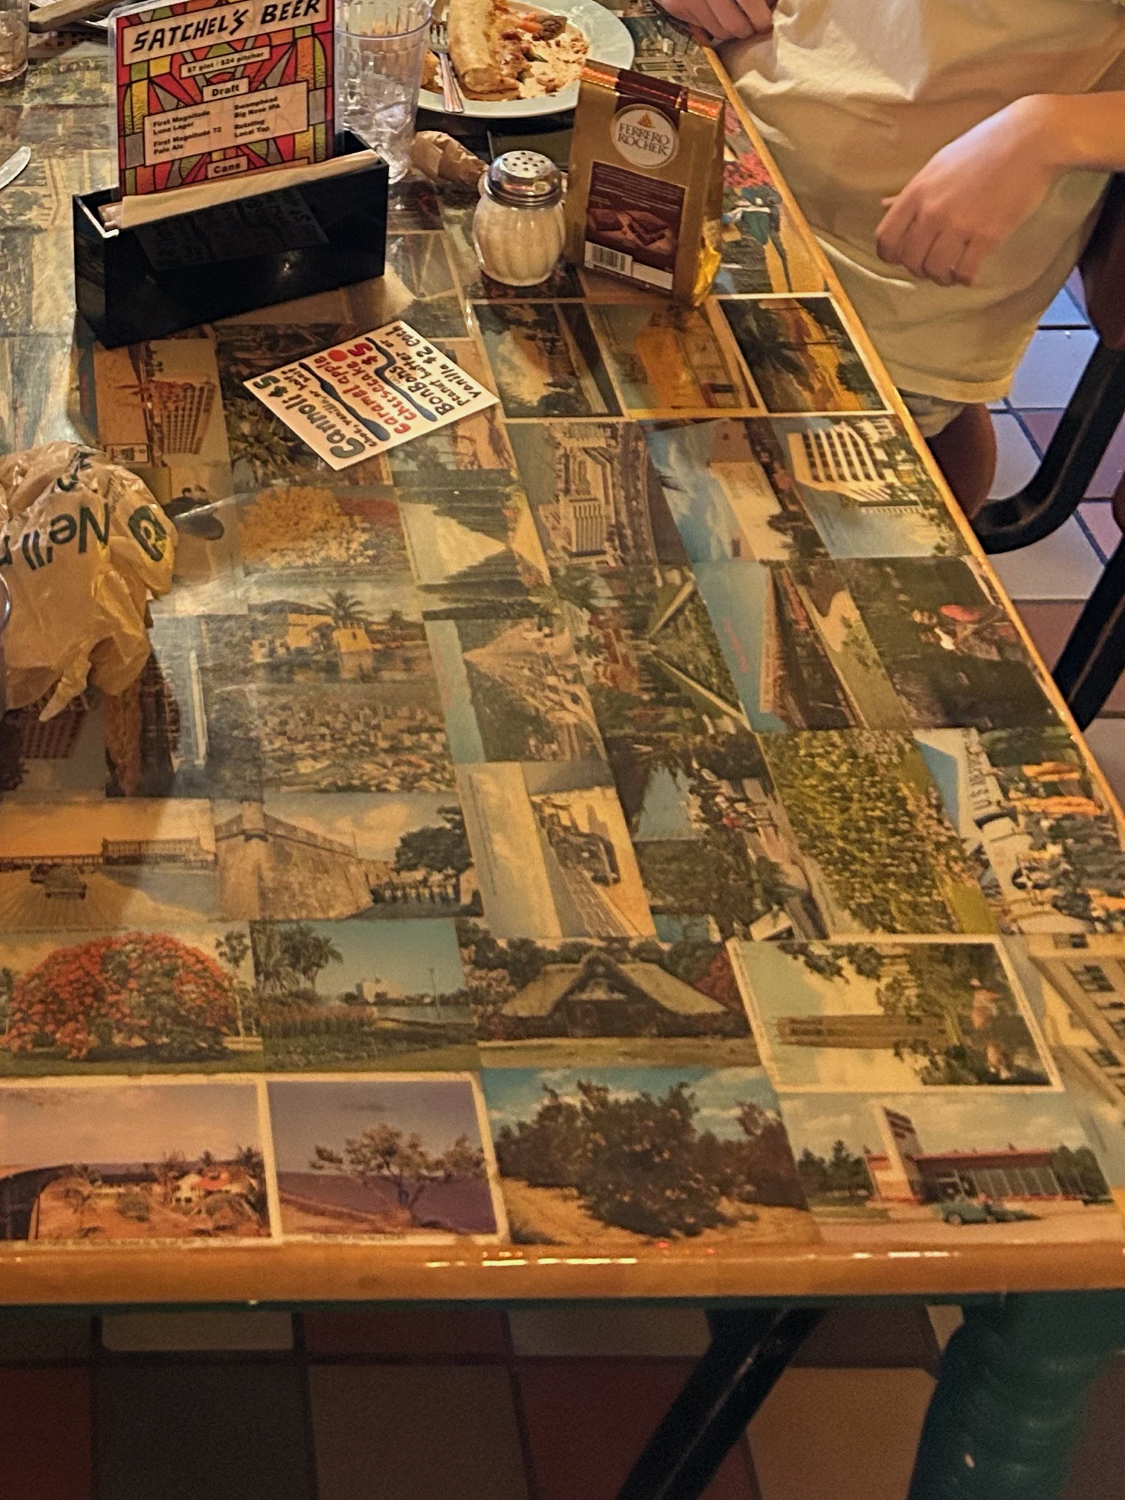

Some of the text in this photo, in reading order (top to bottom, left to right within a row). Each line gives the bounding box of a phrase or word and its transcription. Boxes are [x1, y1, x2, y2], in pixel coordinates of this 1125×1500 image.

[131, 9, 250, 53] SATCHEL'S
[198, 62, 215, 73] pint
[237, 52, 265, 63] pitcher
[212, 84, 241, 98] Draft
[235, 97, 279, 111] Swamphead
[235, 103, 281, 119] Big Nose IPA
[153, 110, 211, 128] First Magnitude
[173, 122, 195, 133] Lager
[235, 118, 266, 131] Rotating
[154, 139, 171, 148] First
[173, 130, 211, 144] Magnitude
[235, 126, 270, 139] Local Tap
[620, 123, 670, 145] FERRERO
[154, 143, 184, 155] Pale Ale
[618, 135, 669, 157] ROCHER
[214, 161, 241, 175] Cans
[347, 343, 378, 366] $5
[385, 325, 482, 399] vanilla $2 each
[314, 356, 350, 384] apple
[379, 340, 471, 407] peanut butter or
[347, 361, 418, 421] cheesecake
[389, 366, 455, 416] BonBons
[253, 375, 366, 459] Cannoli $5
